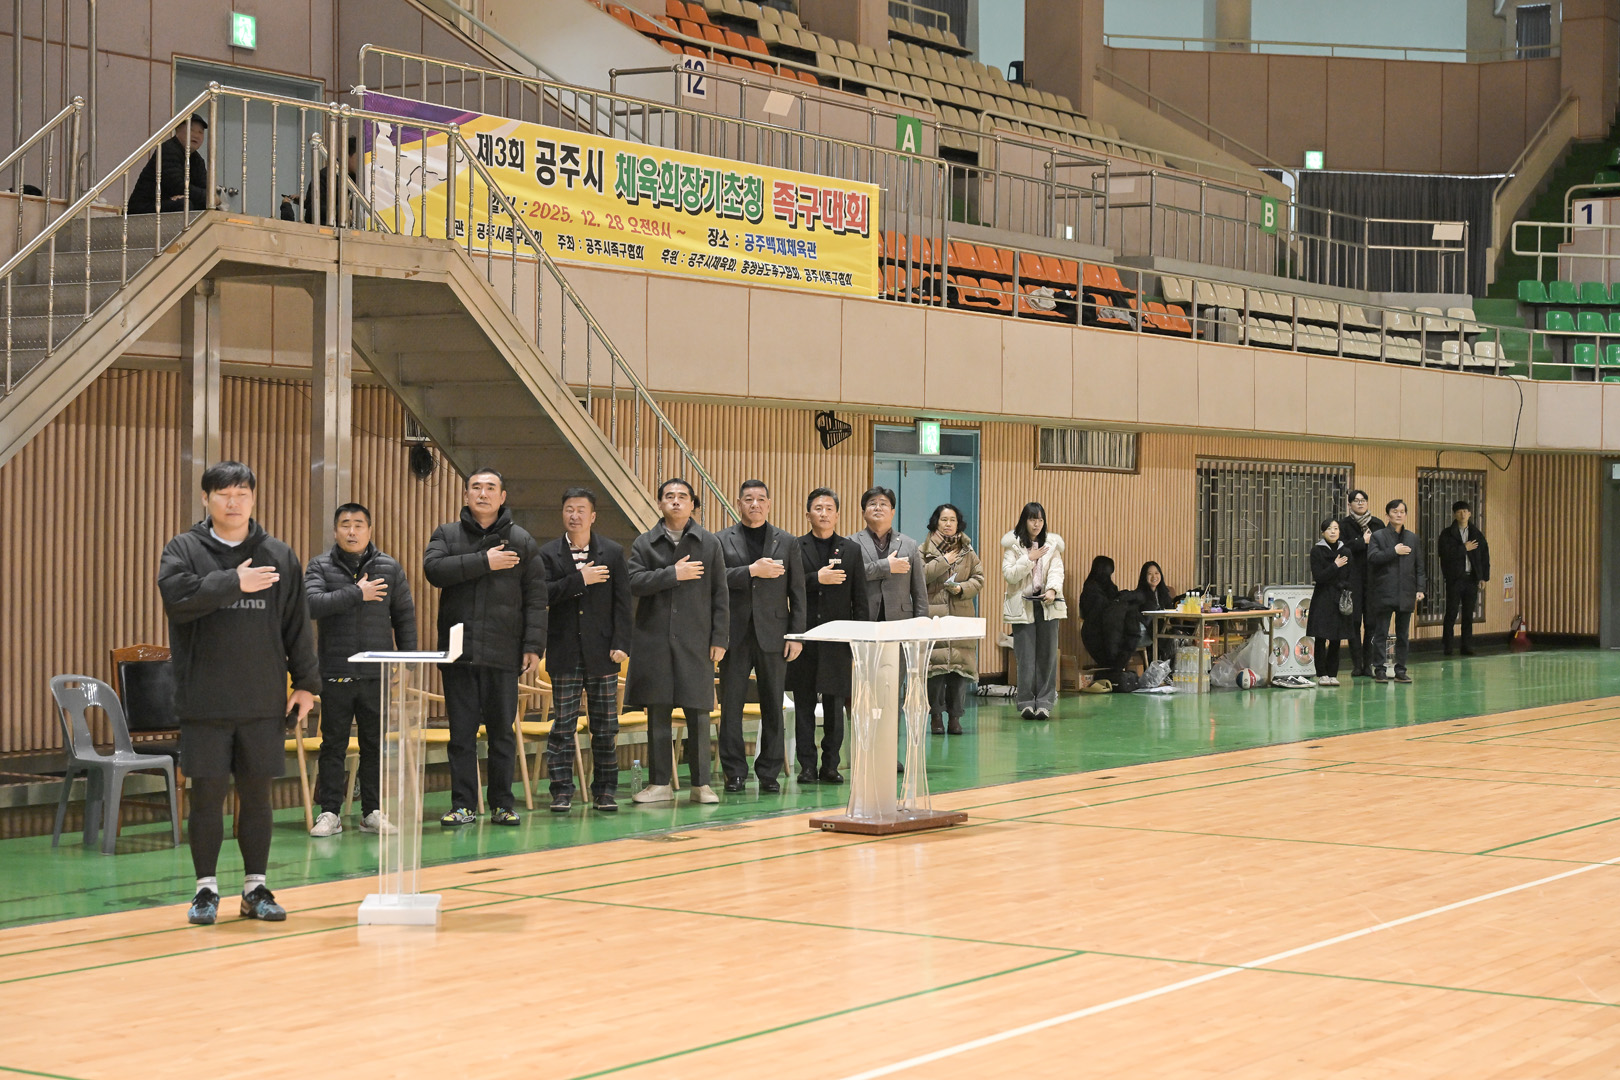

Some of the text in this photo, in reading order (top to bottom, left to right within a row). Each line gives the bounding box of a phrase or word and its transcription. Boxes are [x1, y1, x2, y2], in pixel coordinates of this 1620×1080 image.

[685, 59, 705, 95] 12
[901, 123, 916, 153] A
[475, 133, 869, 232] 제3회 공주시 체육회장기초청 족구대회
[445, 218, 465, 237] 관
[528, 201, 573, 224] 2025.
[580, 210, 601, 228] 12.
[605, 213, 625, 231] 28
[627, 216, 672, 239] 오전8시
[1264, 202, 1275, 228] B
[1581, 203, 1593, 225] 1
[557, 234, 576, 252] 주최
[585, 238, 645, 260] 공주시족구협회
[660, 249, 680, 265] 후원
[707, 228, 729, 248] 장소
[744, 233, 818, 260] 공주백제체육관
